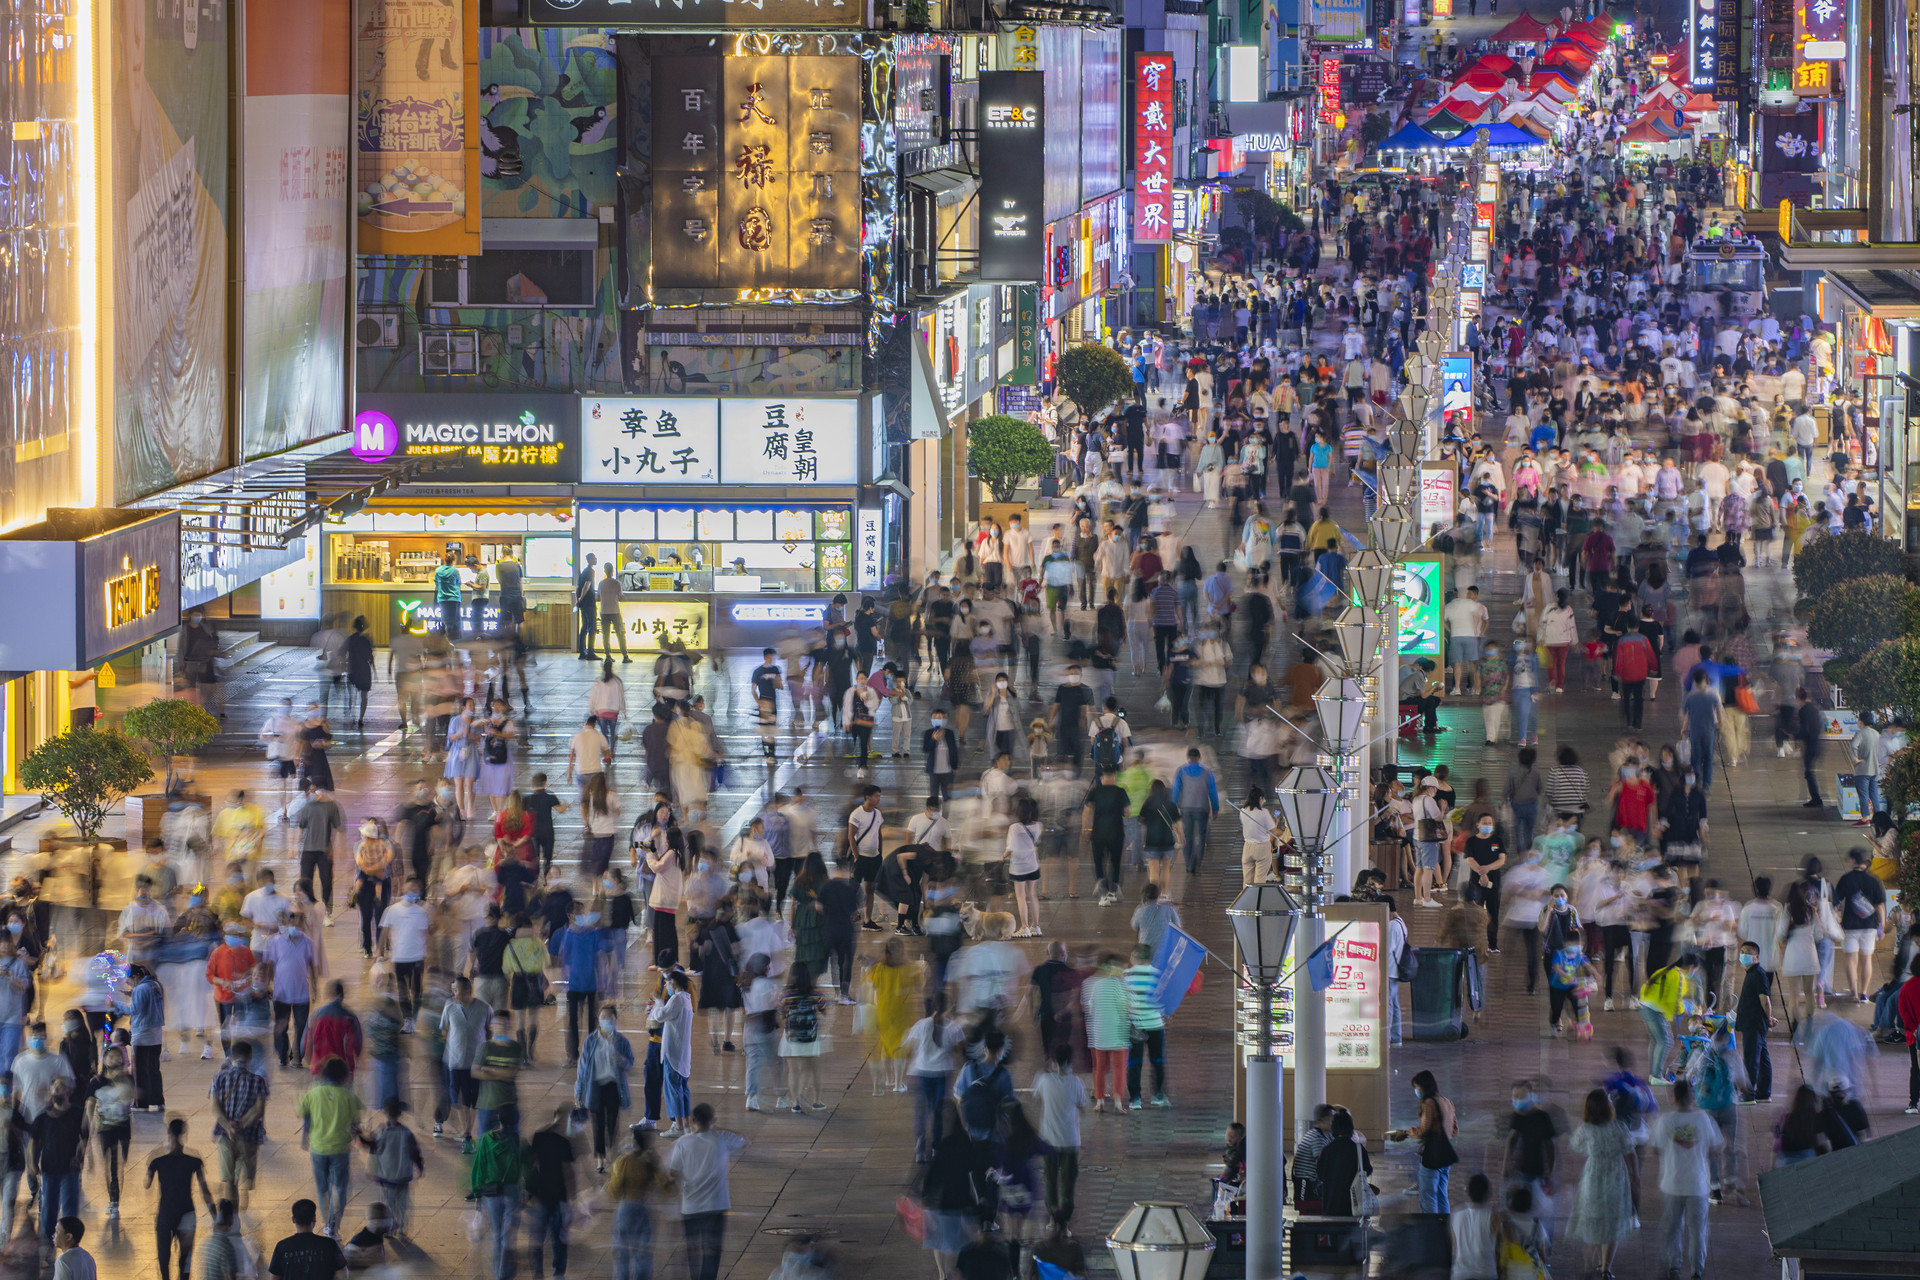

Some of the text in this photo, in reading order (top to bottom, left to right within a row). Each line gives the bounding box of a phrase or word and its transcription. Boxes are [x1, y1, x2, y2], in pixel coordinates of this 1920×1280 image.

[1717, 1, 1736, 77] 国际美肤
[380, 109, 441, 133] 将台球
[988, 106, 1036, 121] EF&C
[379, 132, 441, 152] 进行到底
[1140, 61, 1169, 235] 穿戴大世界
[681, 88, 706, 242] 百年字号
[808, 87, 833, 246] 正宗川菜
[1003, 200, 1016, 209] BY
[361, 422, 385, 451] M
[407, 424, 554, 443] MAGIC LEMON
[619, 408, 682, 439] 章鱼
[762, 403, 790, 460] 豆腐
[406, 445, 432, 455] JUICE
[482, 446, 559, 465] 魔力柠檬
[601, 446, 700, 475] 小丸子
[791, 428, 818, 481] 皇朝
[414, 488, 475, 496] JUICE FRESH TEA
[864, 520, 876, 577] 豆腐皇朝
[1342, 1024, 1370, 1032] 2020
